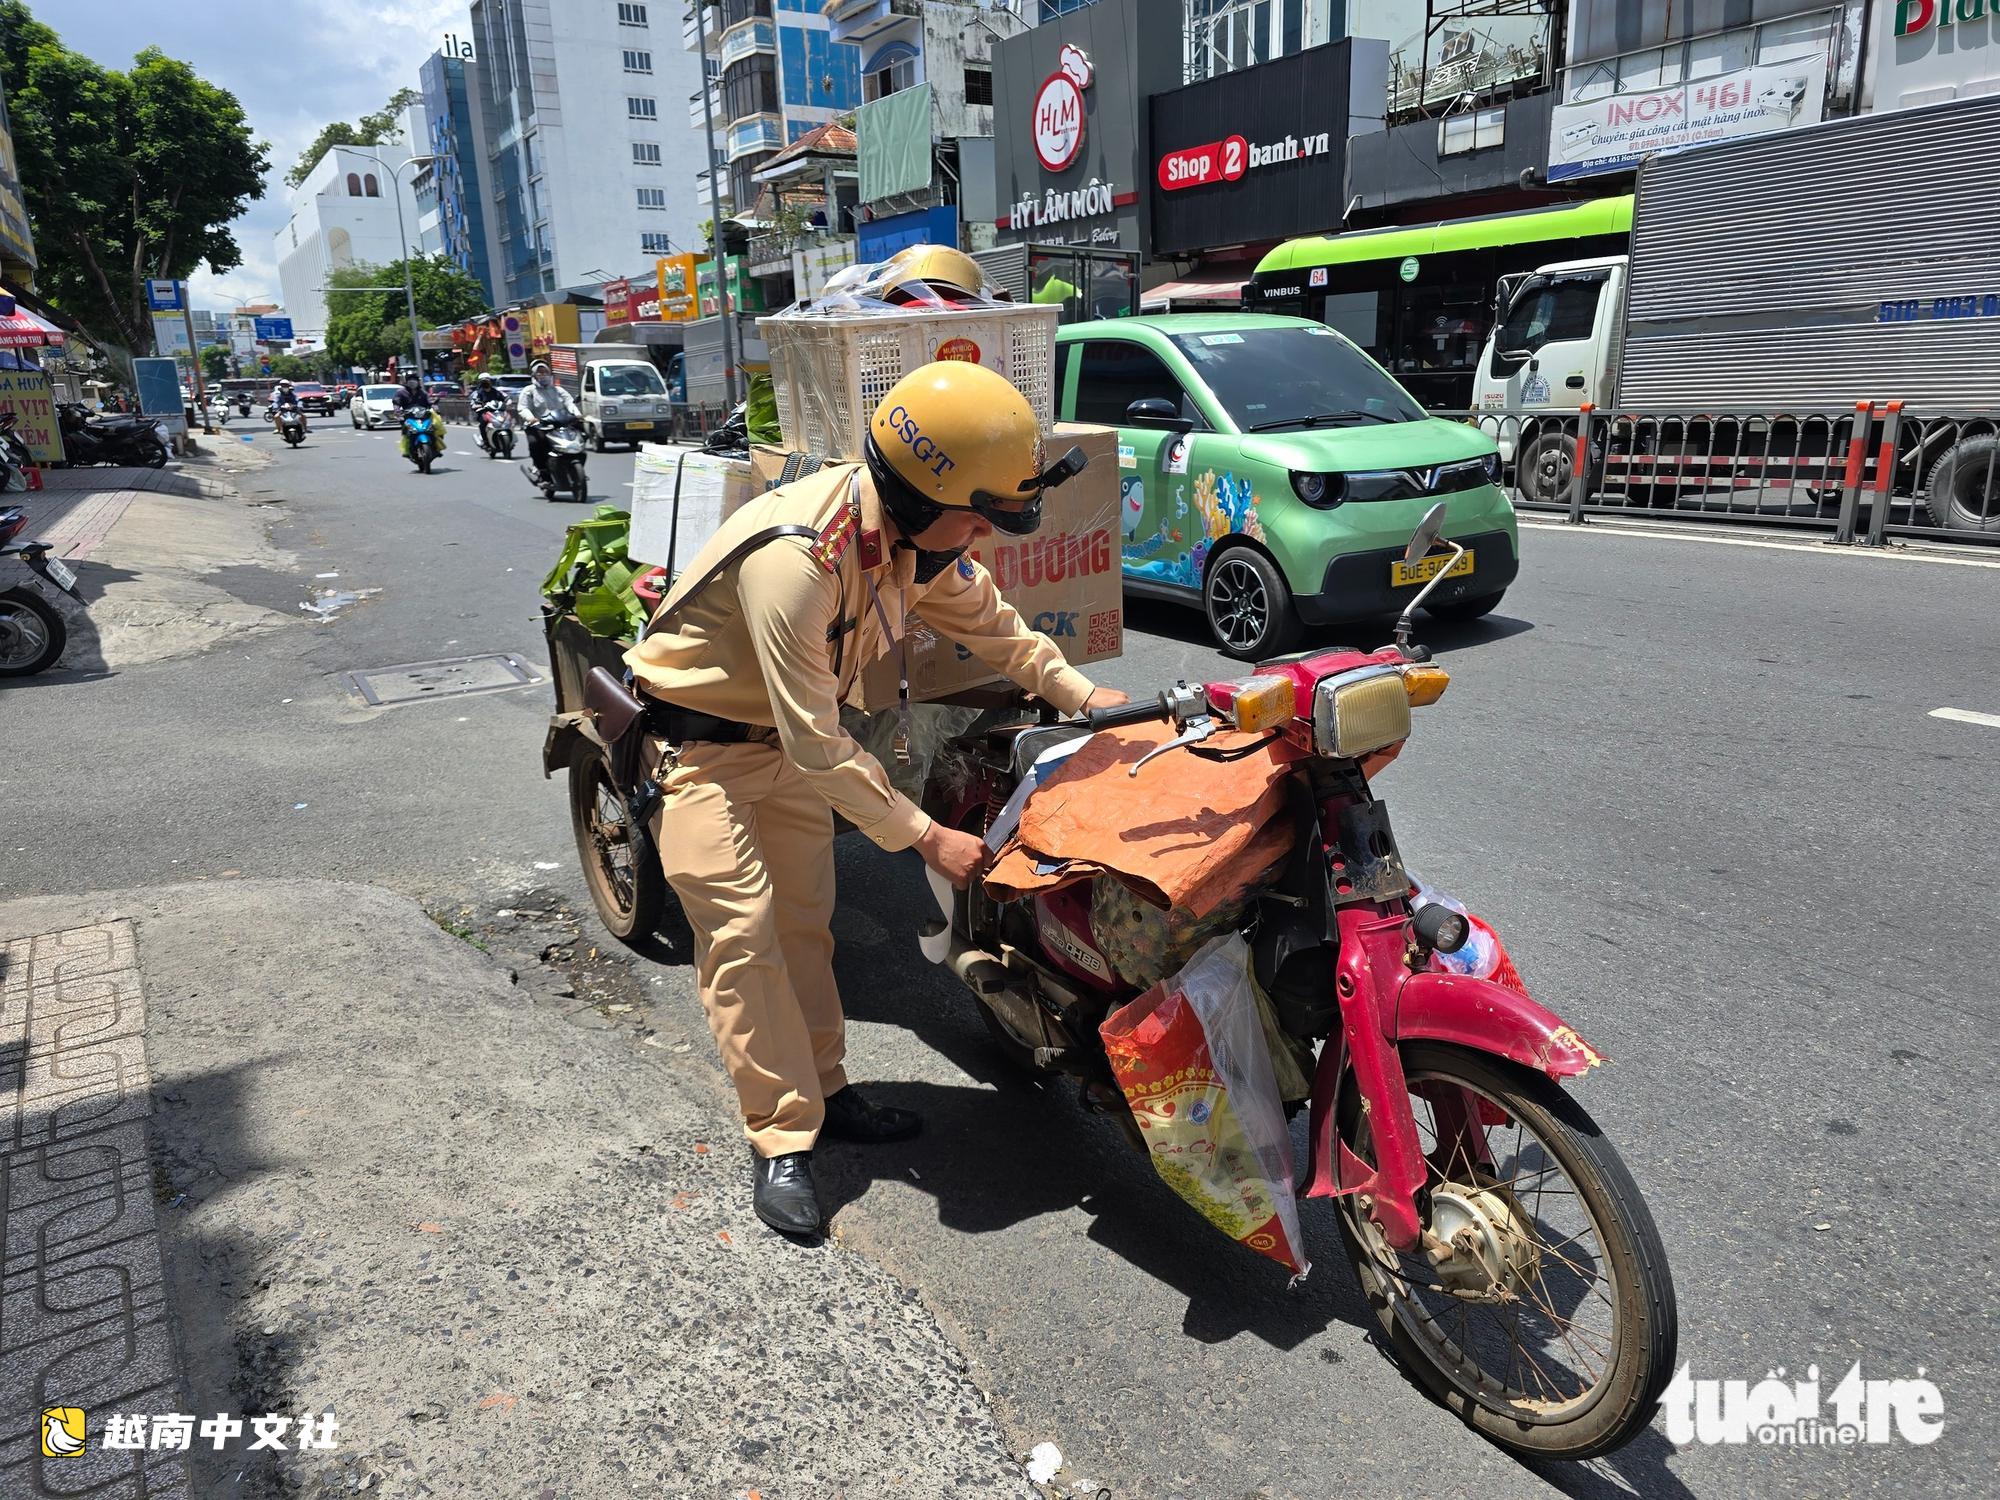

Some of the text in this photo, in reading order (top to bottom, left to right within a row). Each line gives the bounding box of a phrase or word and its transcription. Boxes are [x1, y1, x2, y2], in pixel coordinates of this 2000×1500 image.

[444, 33, 474, 58] ila
[1040, 95, 1075, 136] HLM
[1607, 79, 1752, 129] INOX 461
[1629, 130, 1646, 142] gia
[1647, 123, 1671, 139] công
[1672, 119, 1690, 132] các
[1690, 116, 1713, 130] mặt
[1713, 111, 1741, 127] hàng
[1167, 132, 1329, 181] Shop 2 banh.vn
[1608, 155, 1620, 164] 461
[1033, 188, 1070, 226] LÂM
[1071, 177, 1114, 219] MÔN
[1312, 270, 1324, 284] 64
[1263, 286, 1301, 298] VINBUS
[17, 377, 44, 391] HUY
[19, 399, 48, 420] VỊT
[889, 406, 956, 477] CSGT
